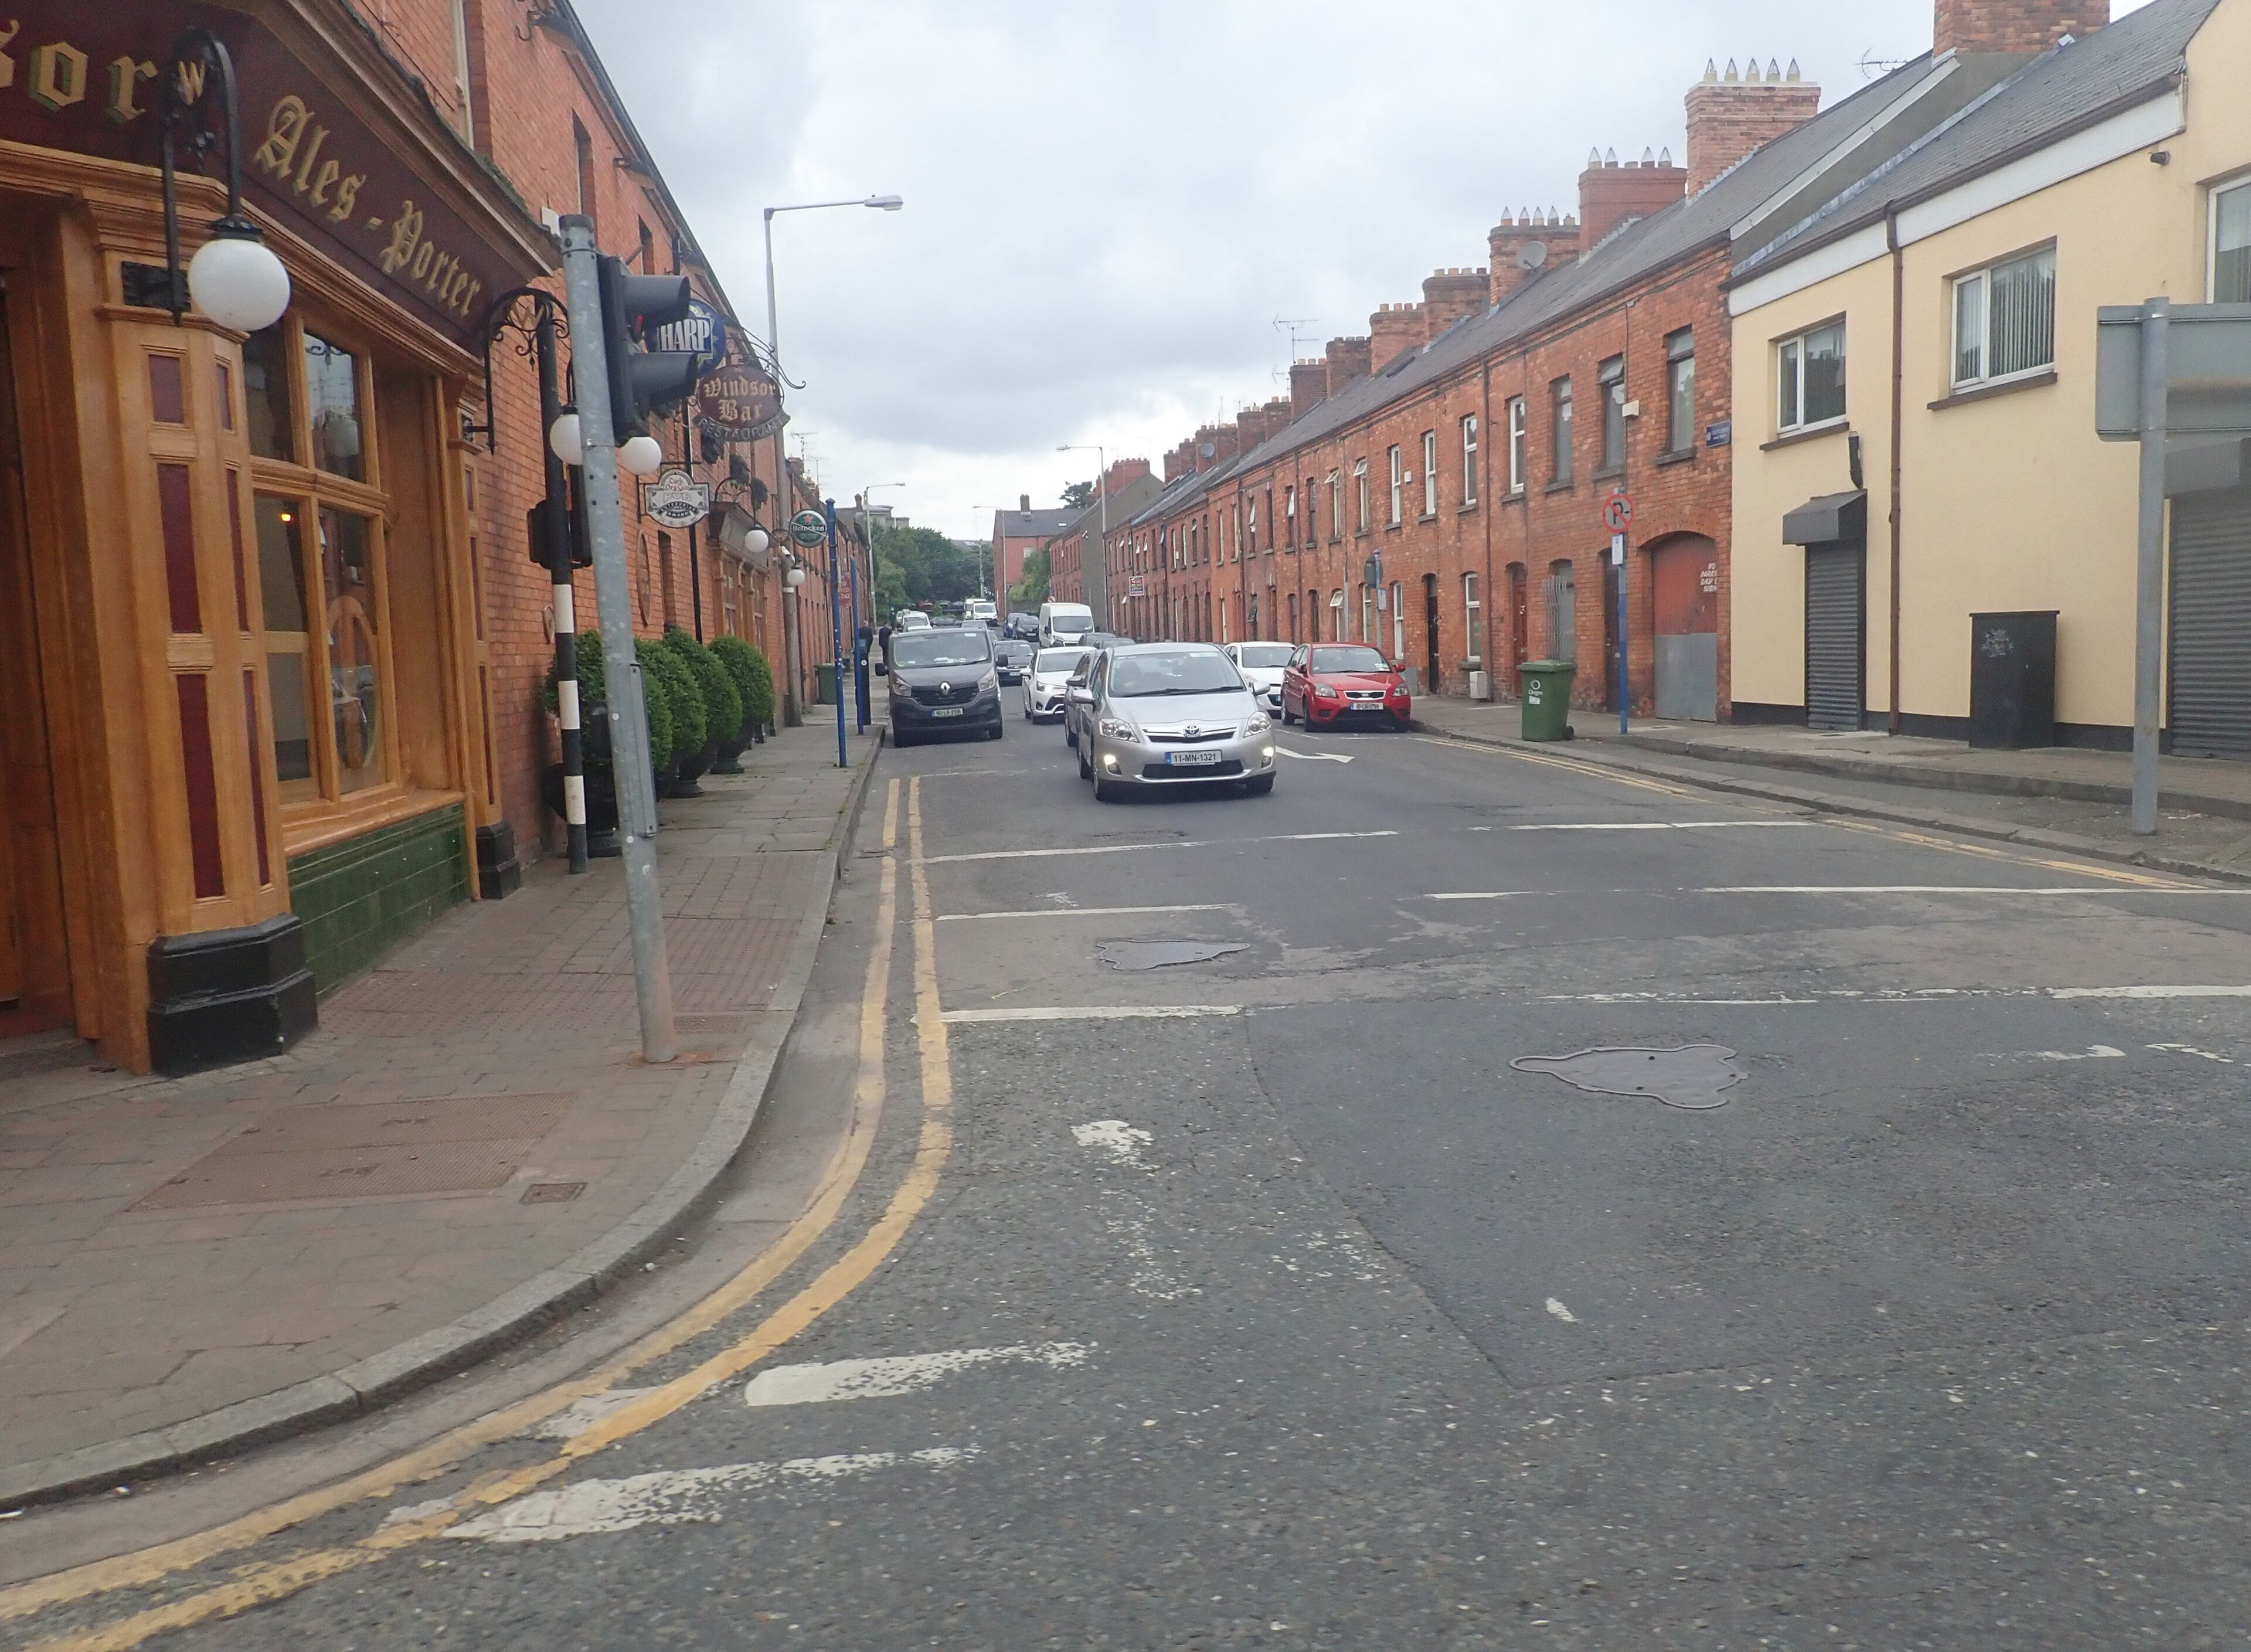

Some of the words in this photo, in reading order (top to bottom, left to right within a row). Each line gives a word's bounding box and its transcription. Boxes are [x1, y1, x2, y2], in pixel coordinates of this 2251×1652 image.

[254, 94, 366, 223] Ales
[379, 199, 481, 318] Porter
[660, 318, 711, 352] HARP
[704, 375, 776, 398] Windsor
[717, 399, 763, 423] Bar
[698, 416, 784, 440] RESTAURANT
[664, 492, 691, 503] PUB
[1174, 753, 1216, 763] 11-MN-1321
